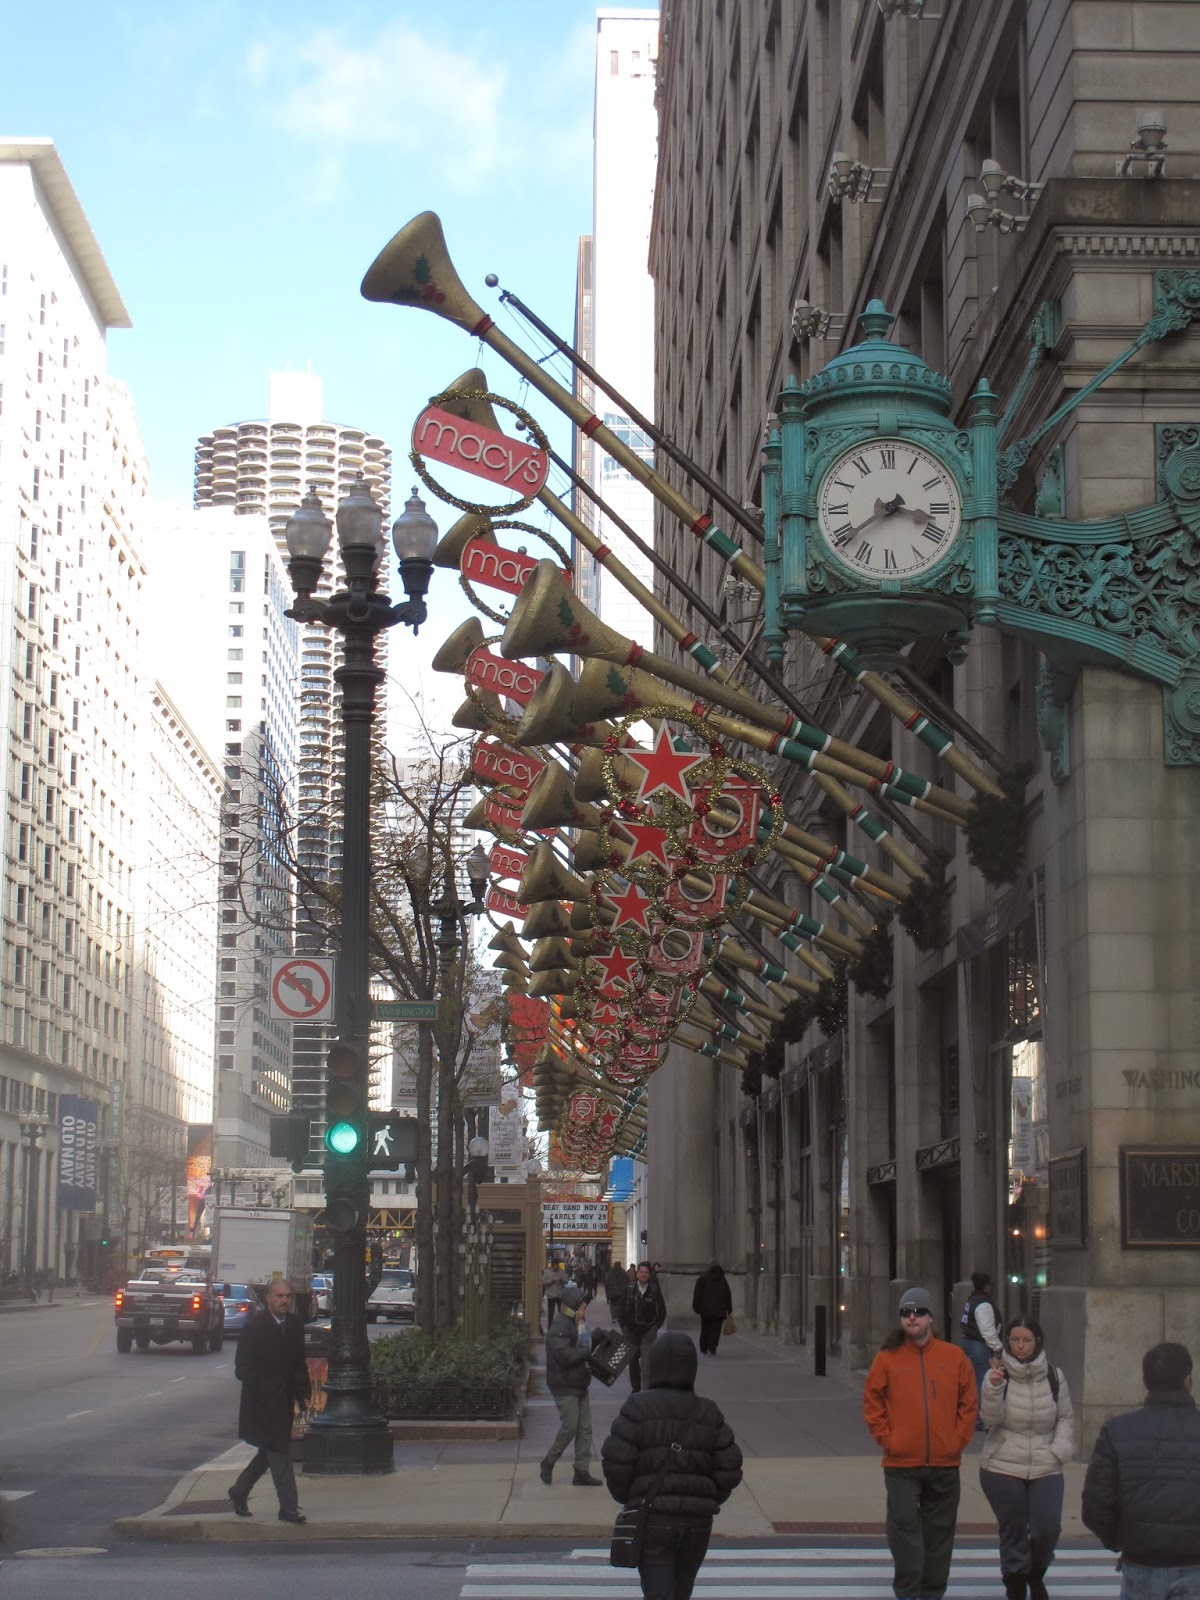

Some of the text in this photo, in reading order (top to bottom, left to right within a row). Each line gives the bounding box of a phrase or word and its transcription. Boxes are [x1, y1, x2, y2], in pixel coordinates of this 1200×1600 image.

[467, 548, 534, 584] mac
[474, 748, 541, 787] macy
[380, 1005, 434, 1017] WASHINGTON
[60, 1115, 75, 1186] OLD NAVY
[552, 1222, 561, 1230] NO
[562, 1222, 588, 1230] CHASER
